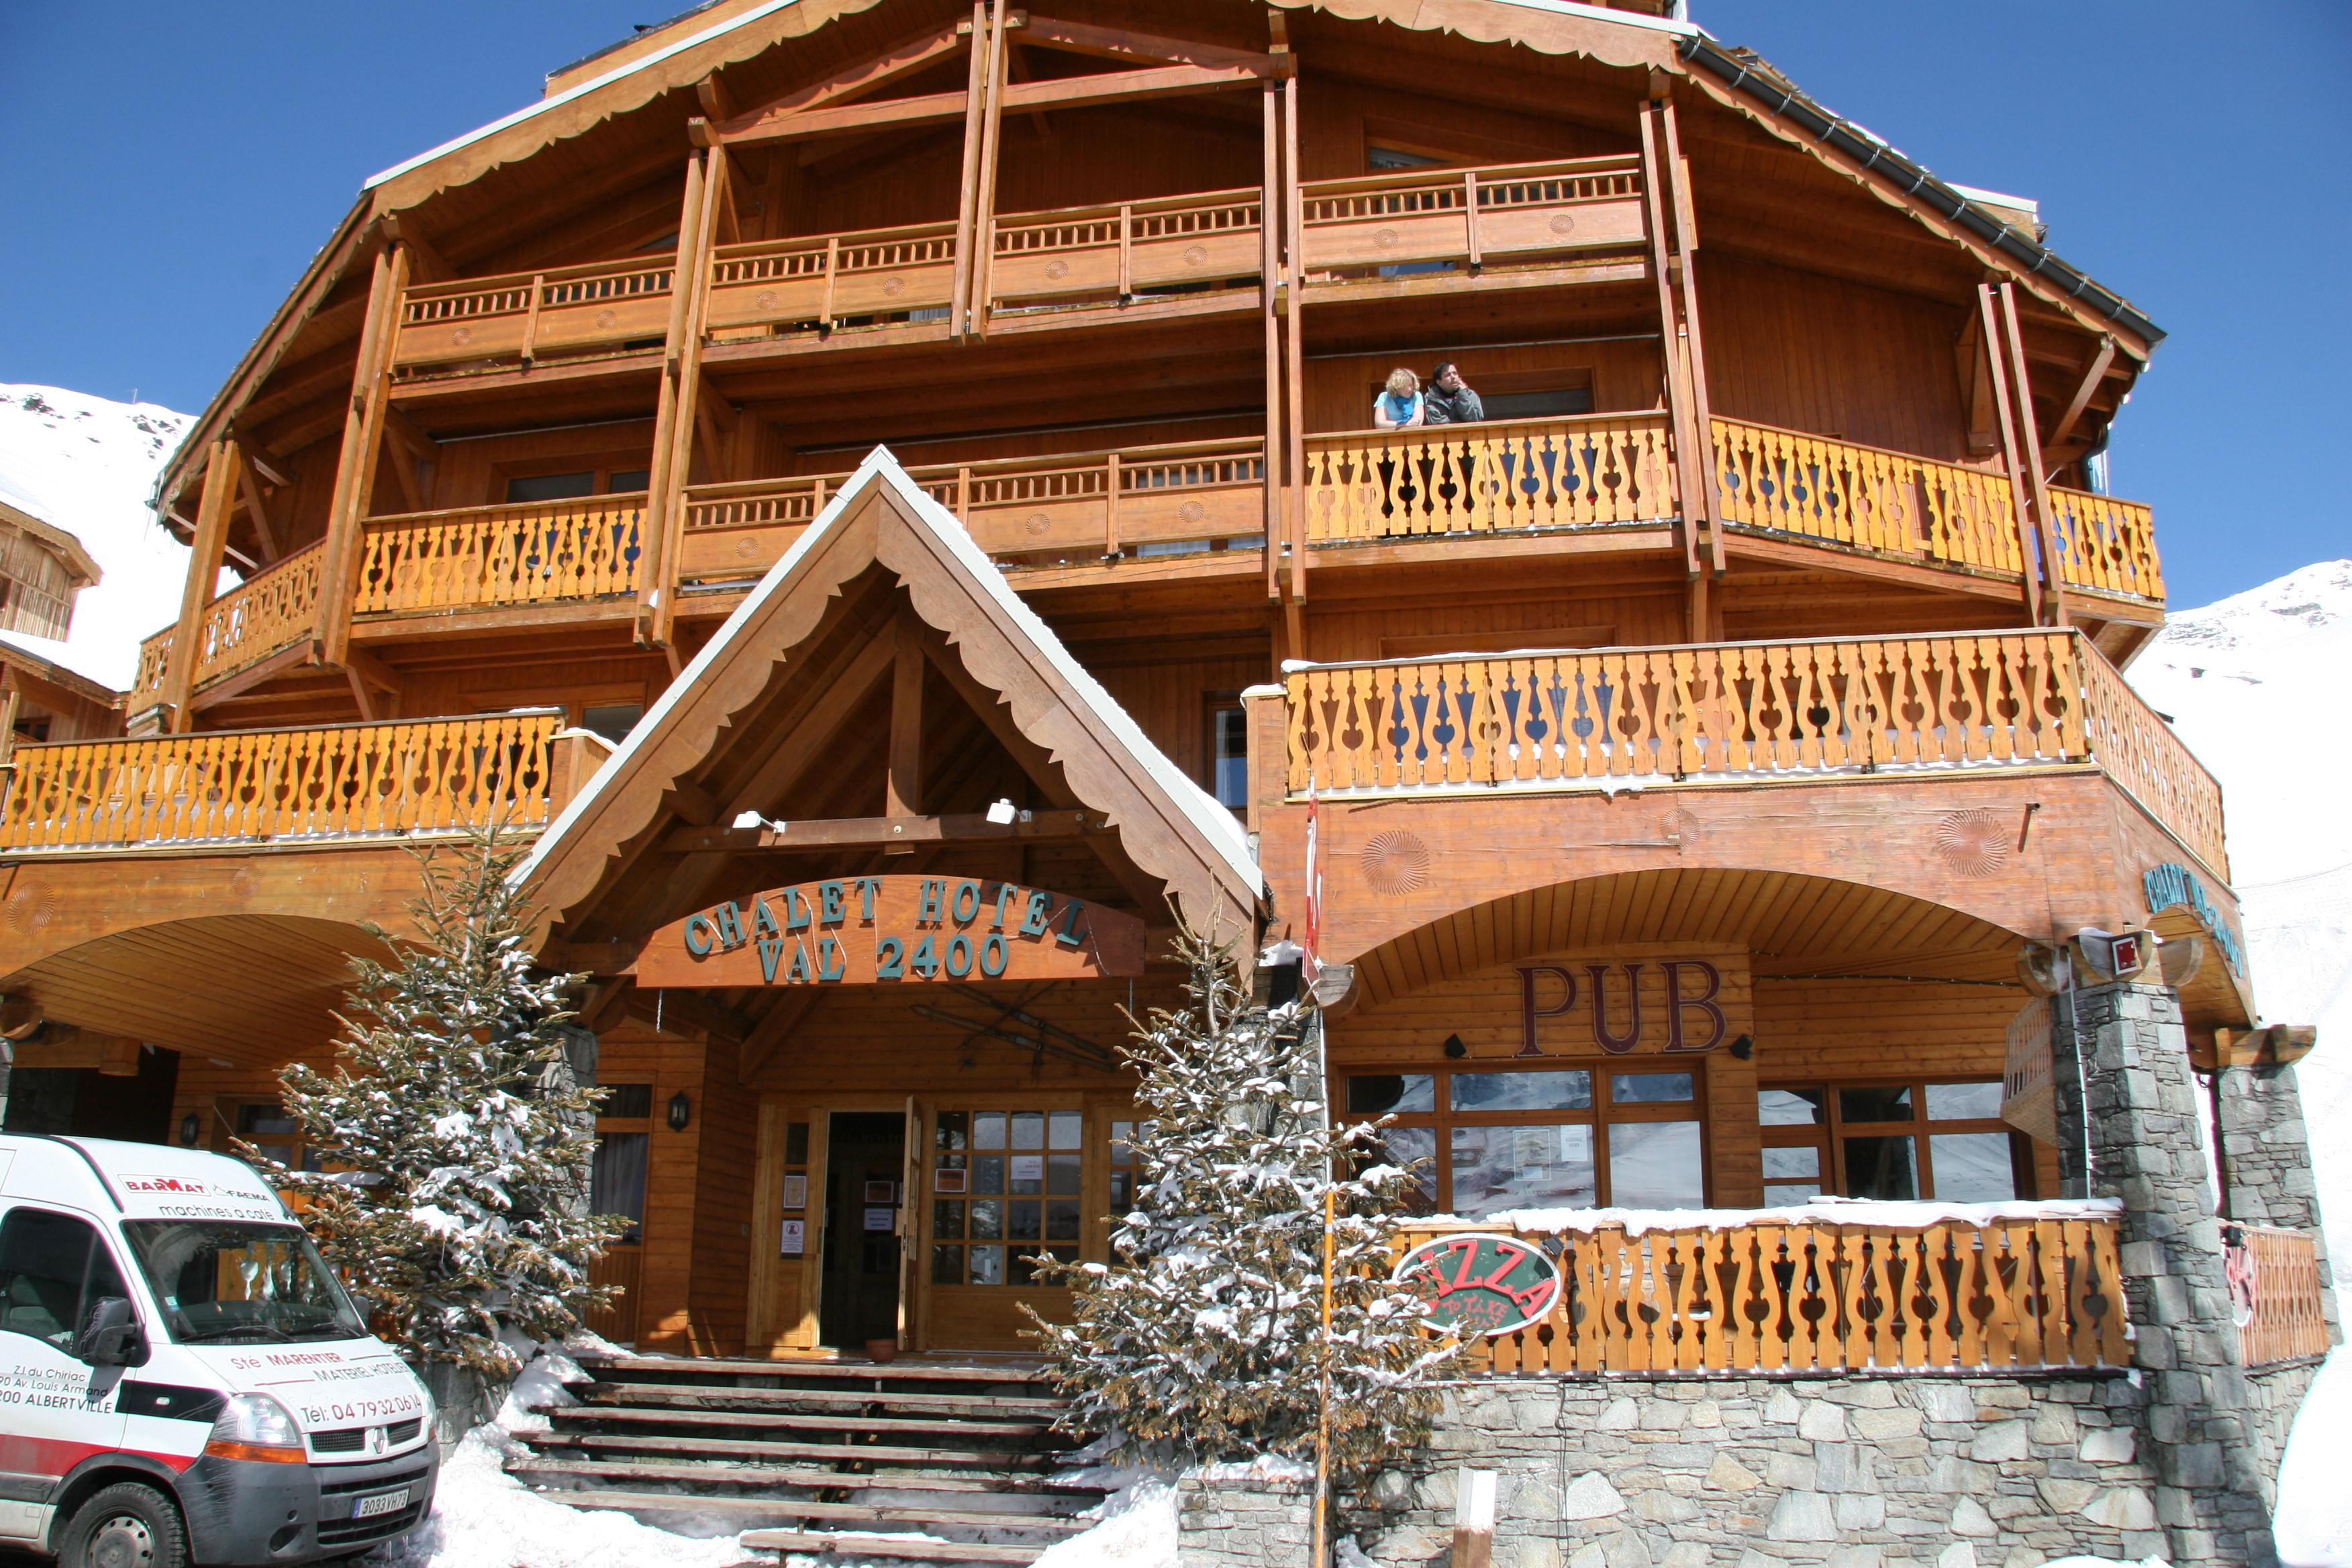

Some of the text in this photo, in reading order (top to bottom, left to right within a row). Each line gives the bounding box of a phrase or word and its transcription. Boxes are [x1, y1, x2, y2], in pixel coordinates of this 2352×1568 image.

[684, 877, 1088, 955] CHALET HOTEL
[758, 934, 1009, 983] VAL 2400
[1514, 960, 1727, 1057] PUB
[126, 1178, 205, 1193] BARMAT
[227, 1190, 271, 1202] FAEMA
[158, 1205, 232, 1218] machines
[1404, 1240, 1557, 1320] IZZA
[1440, 1295, 1510, 1318] TO TAKE
[230, 1352, 345, 1370] Sté MARENTIER
[28, 1367, 42, 1377] du
[46, 1369, 87, 1382] Chiriac
[313, 1367, 375, 1381] MATERIEL
[13, 1378, 28, 1388] Av.
[31, 1379, 59, 1392] Louis
[61, 1383, 109, 1398] Armand
[25, 1393, 113, 1414] ALBERTVILLE
[332, 1404, 356, 1420] 04
[363, 1498, 387, 1514] 3033
[397, 1492, 407, 1506] 73
